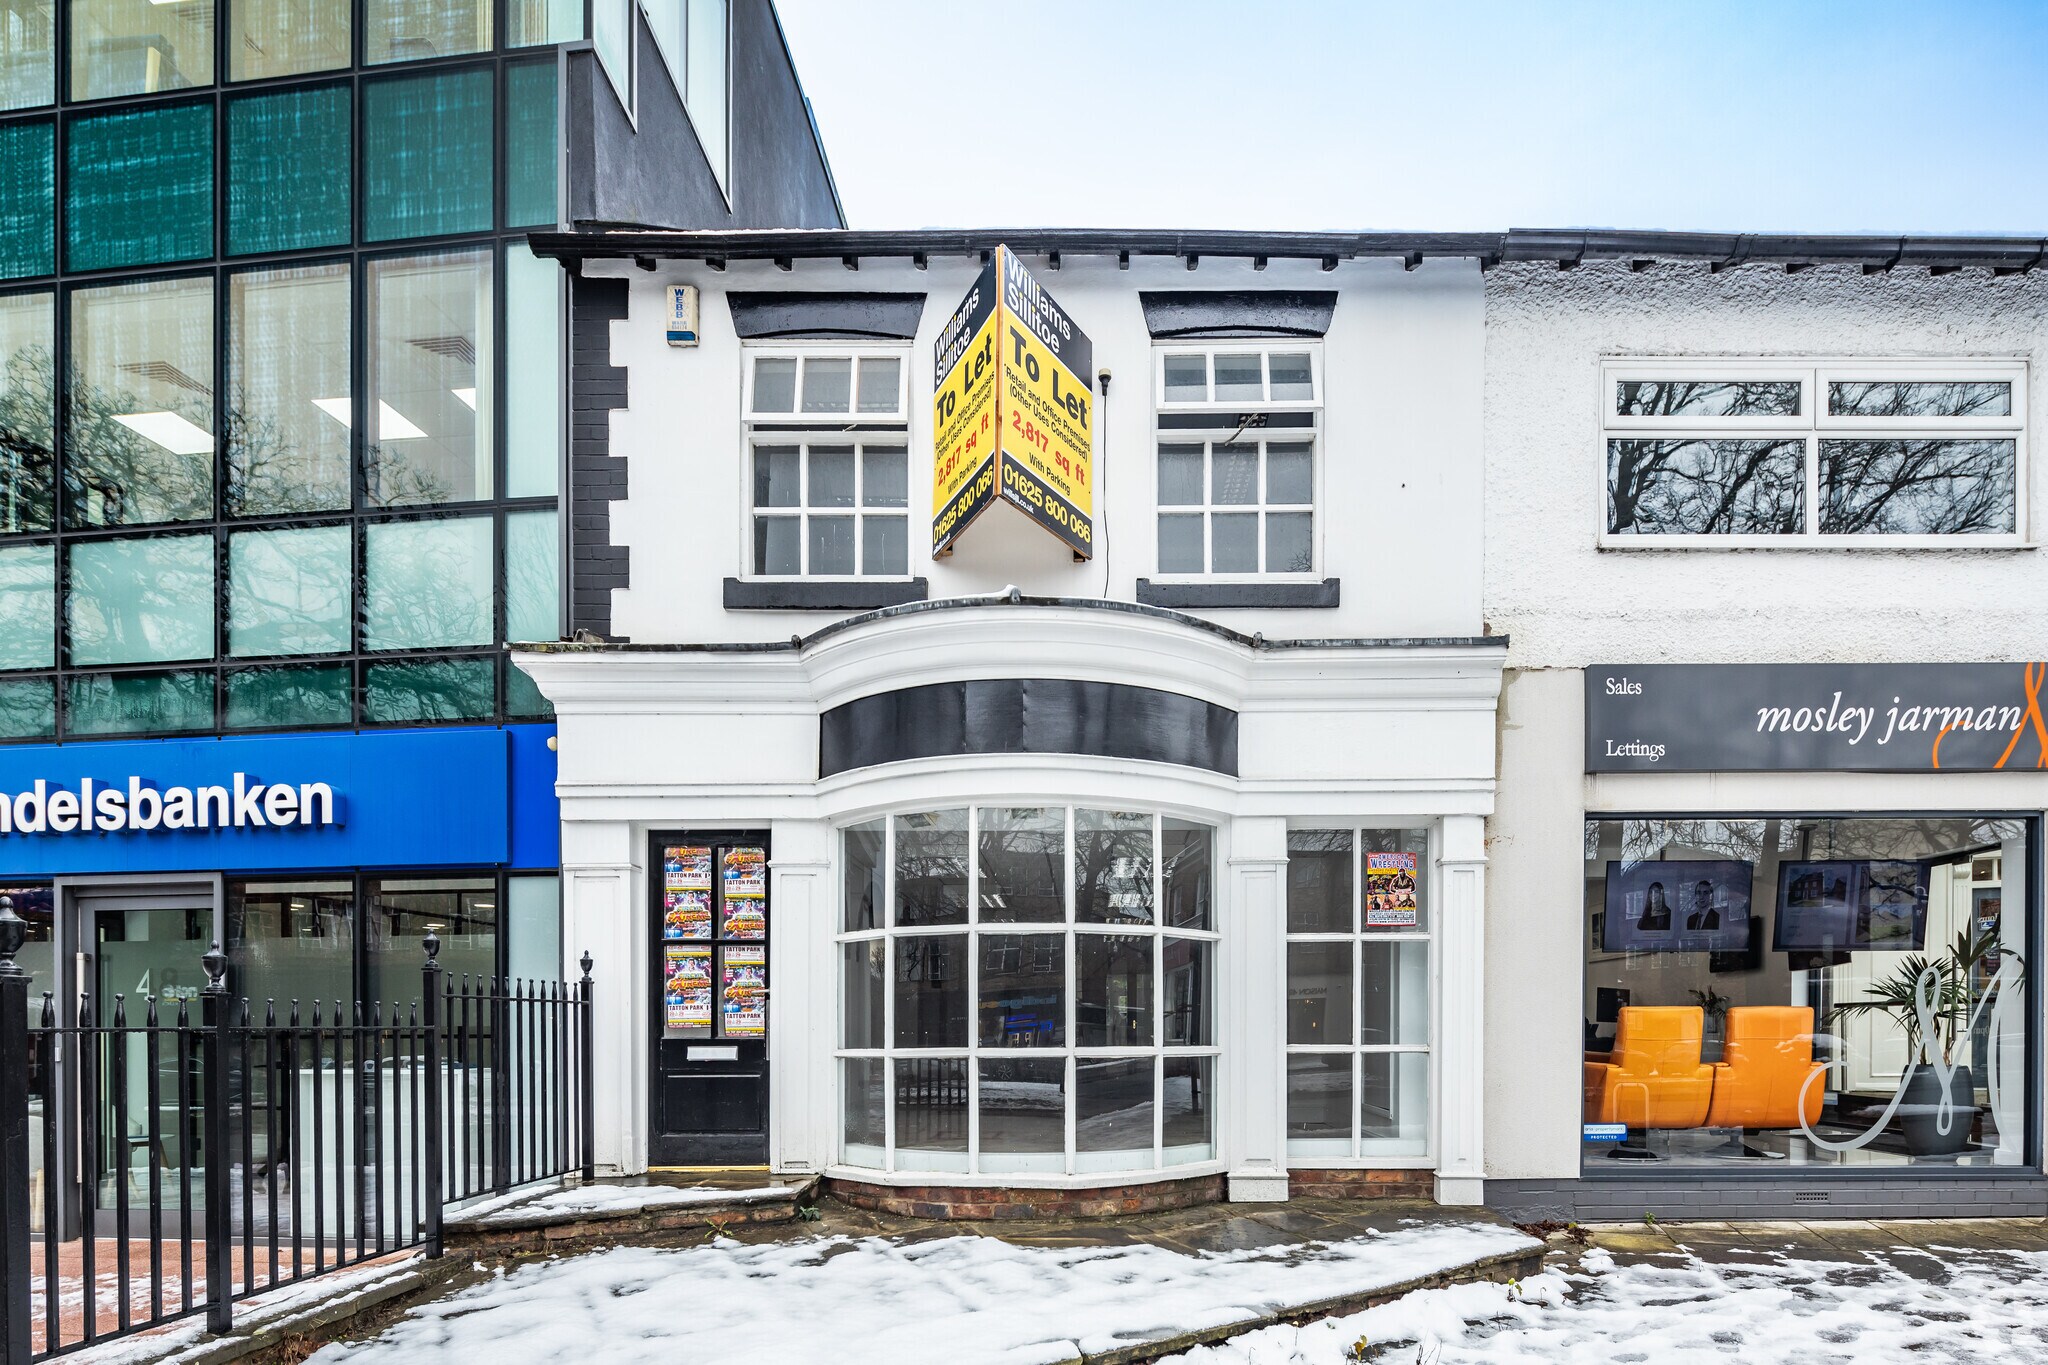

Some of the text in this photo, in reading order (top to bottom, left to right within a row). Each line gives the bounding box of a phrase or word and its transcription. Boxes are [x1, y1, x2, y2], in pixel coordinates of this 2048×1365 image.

[674, 289, 684, 318] WEBB
[935, 287, 979, 361] Williams
[1007, 251, 1071, 341] Williams
[1008, 282, 1060, 354] Sillitoe
[936, 326, 971, 386] Sillitoe
[936, 332, 992, 428] To Let
[1010, 325, 1088, 430] To Let
[950, 426, 962, 443] Uses
[1006, 369, 1090, 451] Retail and Office Premises
[1009, 383, 1088, 463] (Other Uses Considered)
[938, 411, 989, 487] 2,817 sq ft
[959, 456, 977, 484] Parking
[1012, 410, 1085, 486] 2,817 sq ft
[1029, 452, 1071, 496] With Parking
[933, 506, 957, 544] 01625
[957, 486, 975, 518] 800
[976, 464, 993, 498] 066
[1004, 463, 1091, 543] 01625 800 066
[1605, 677, 1642, 695] Sales
[1757, 692, 2021, 744] mosley jarman
[1605, 740, 1665, 762] Lettings
